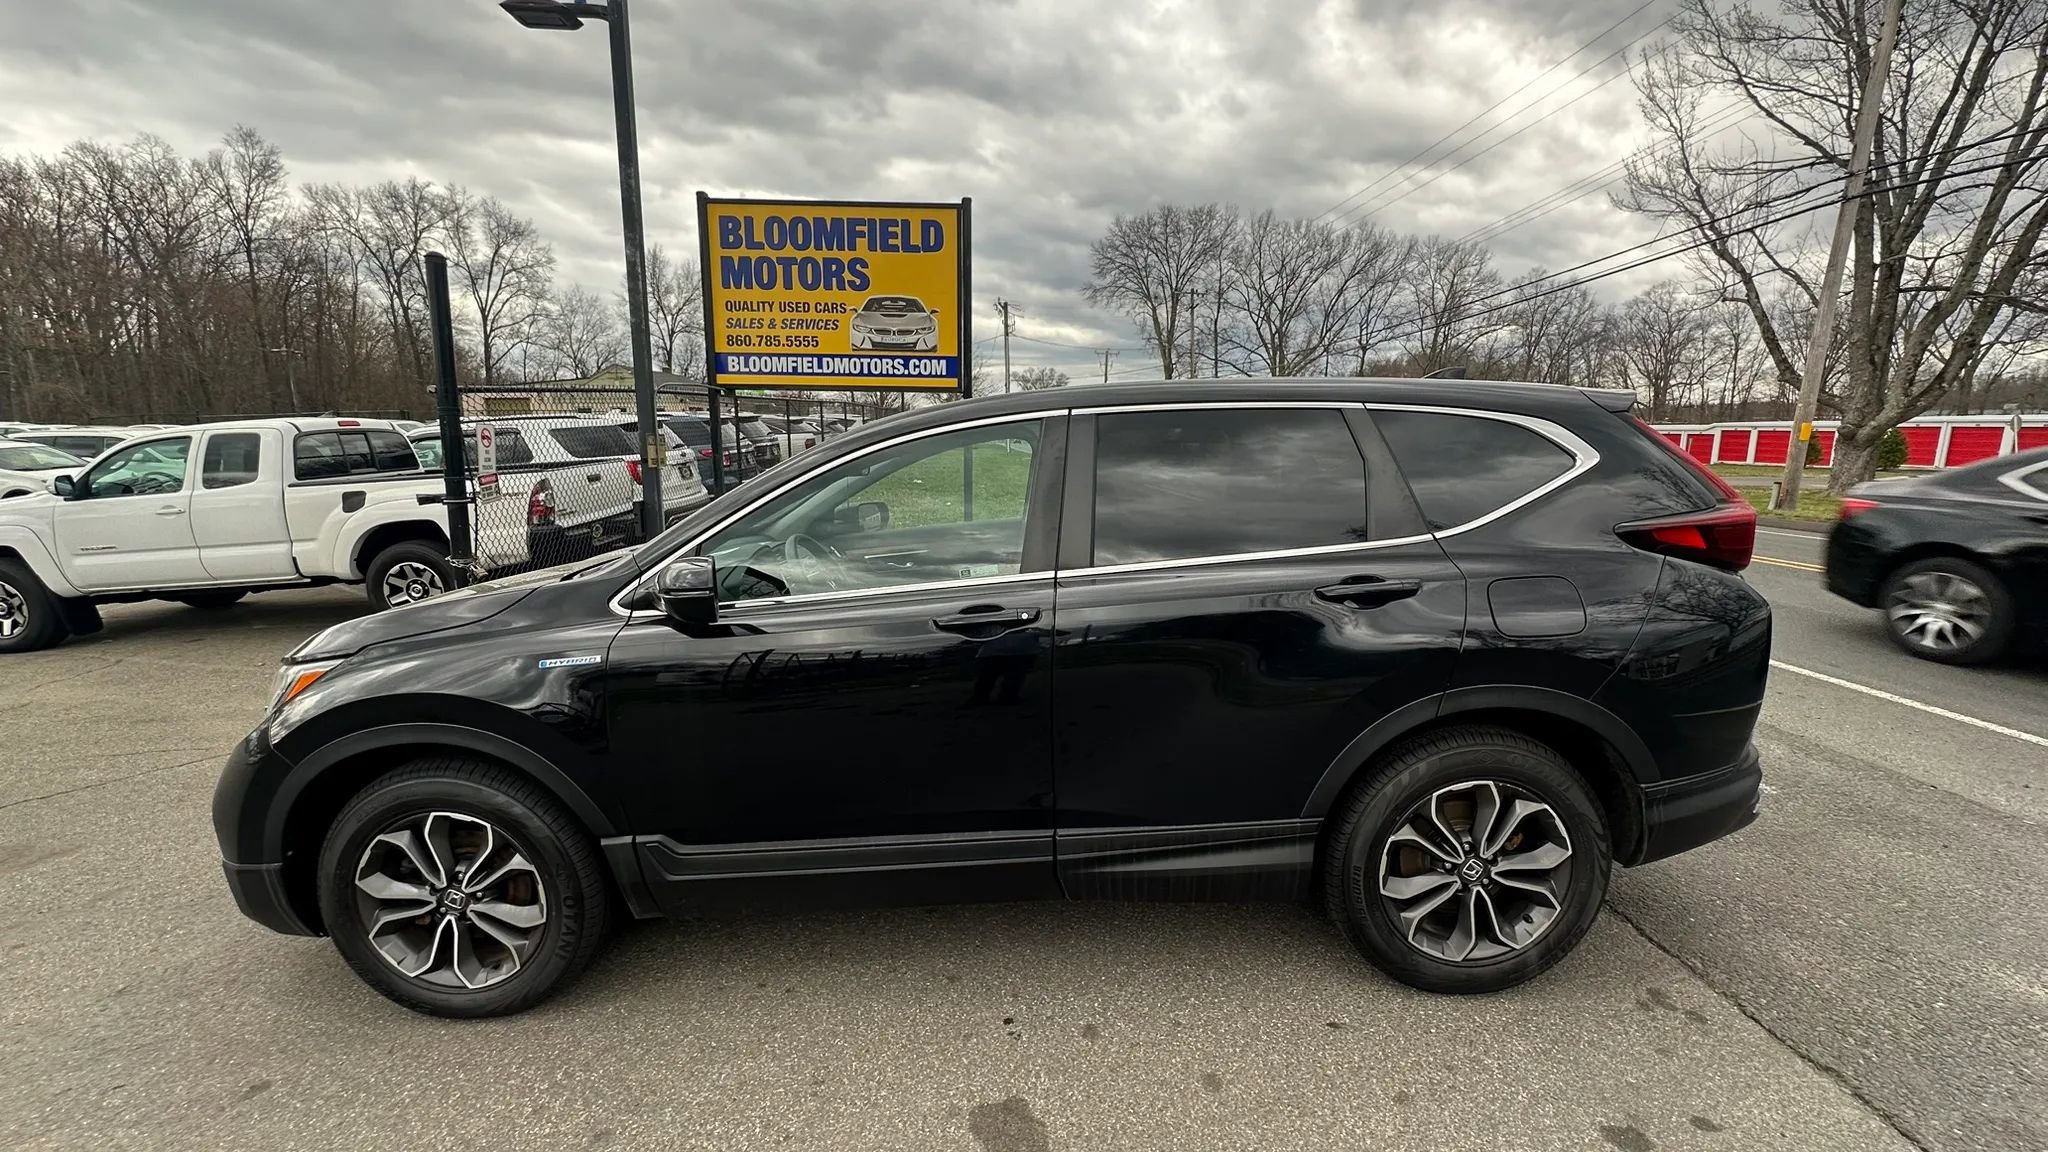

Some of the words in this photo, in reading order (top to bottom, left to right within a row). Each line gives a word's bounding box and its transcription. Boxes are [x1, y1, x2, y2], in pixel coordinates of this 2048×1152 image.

[718, 215, 945, 253] BLOOMFIELD
[720, 256, 871, 291] MOTORS
[725, 300, 775, 313] QUALITY
[779, 301, 811, 314] USED
[814, 302, 847, 314] CARS
[726, 318, 764, 329] SALES
[768, 319, 777, 330] &
[781, 319, 840, 331] SERVICES
[726, 334, 819, 348] 860.785.5555
[727, 356, 947, 375] BLOOMFIELDMOTORS.COM
